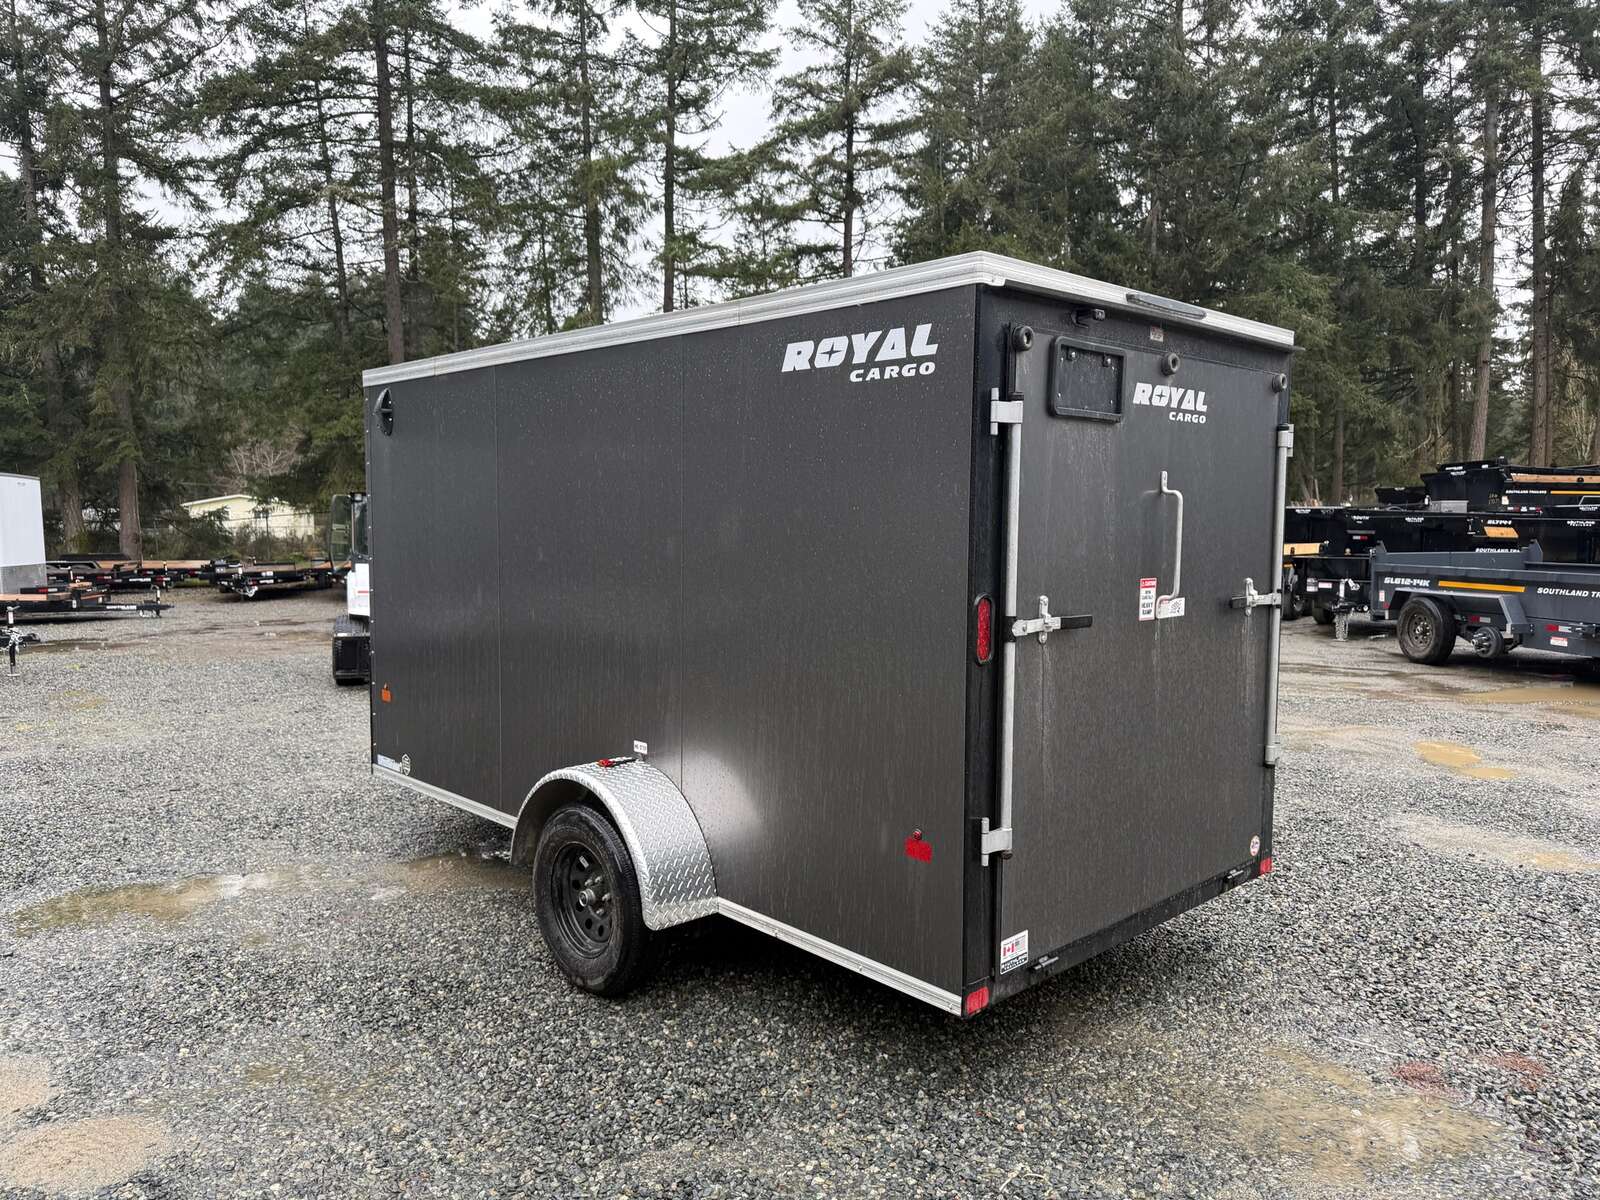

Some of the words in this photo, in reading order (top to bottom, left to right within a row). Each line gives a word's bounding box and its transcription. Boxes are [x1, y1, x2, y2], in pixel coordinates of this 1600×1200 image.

[781, 323, 939, 372] ROYAL
[850, 361, 936, 383] CARGO
[1132, 382, 1208, 412] ROYAL
[1168, 411, 1207, 424] CARGO
[1536, 587, 1589, 597] SOUTHLAND
